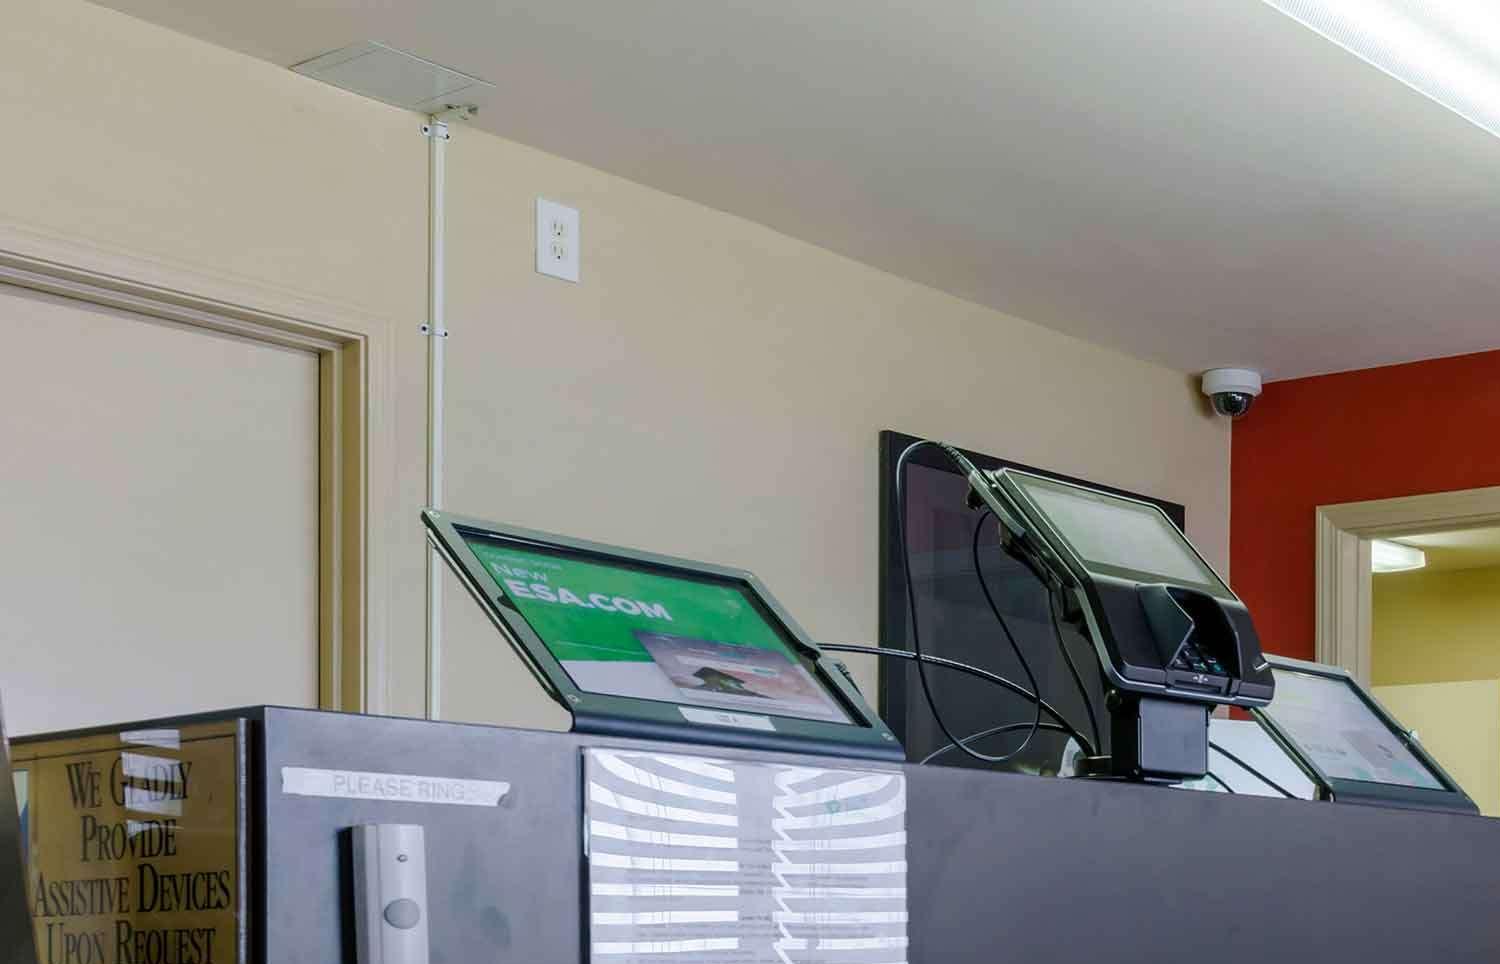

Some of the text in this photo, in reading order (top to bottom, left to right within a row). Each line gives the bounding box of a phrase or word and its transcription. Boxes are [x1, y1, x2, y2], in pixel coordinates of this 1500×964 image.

[504, 577, 673, 622] ESA.COM
[66, 755, 192, 809] WE GLADLY
[333, 774, 465, 800] PLEASE RING
[80, 815, 177, 863] PROVIDE
[33, 863, 231, 918] ASSISTIVE DEVICES
